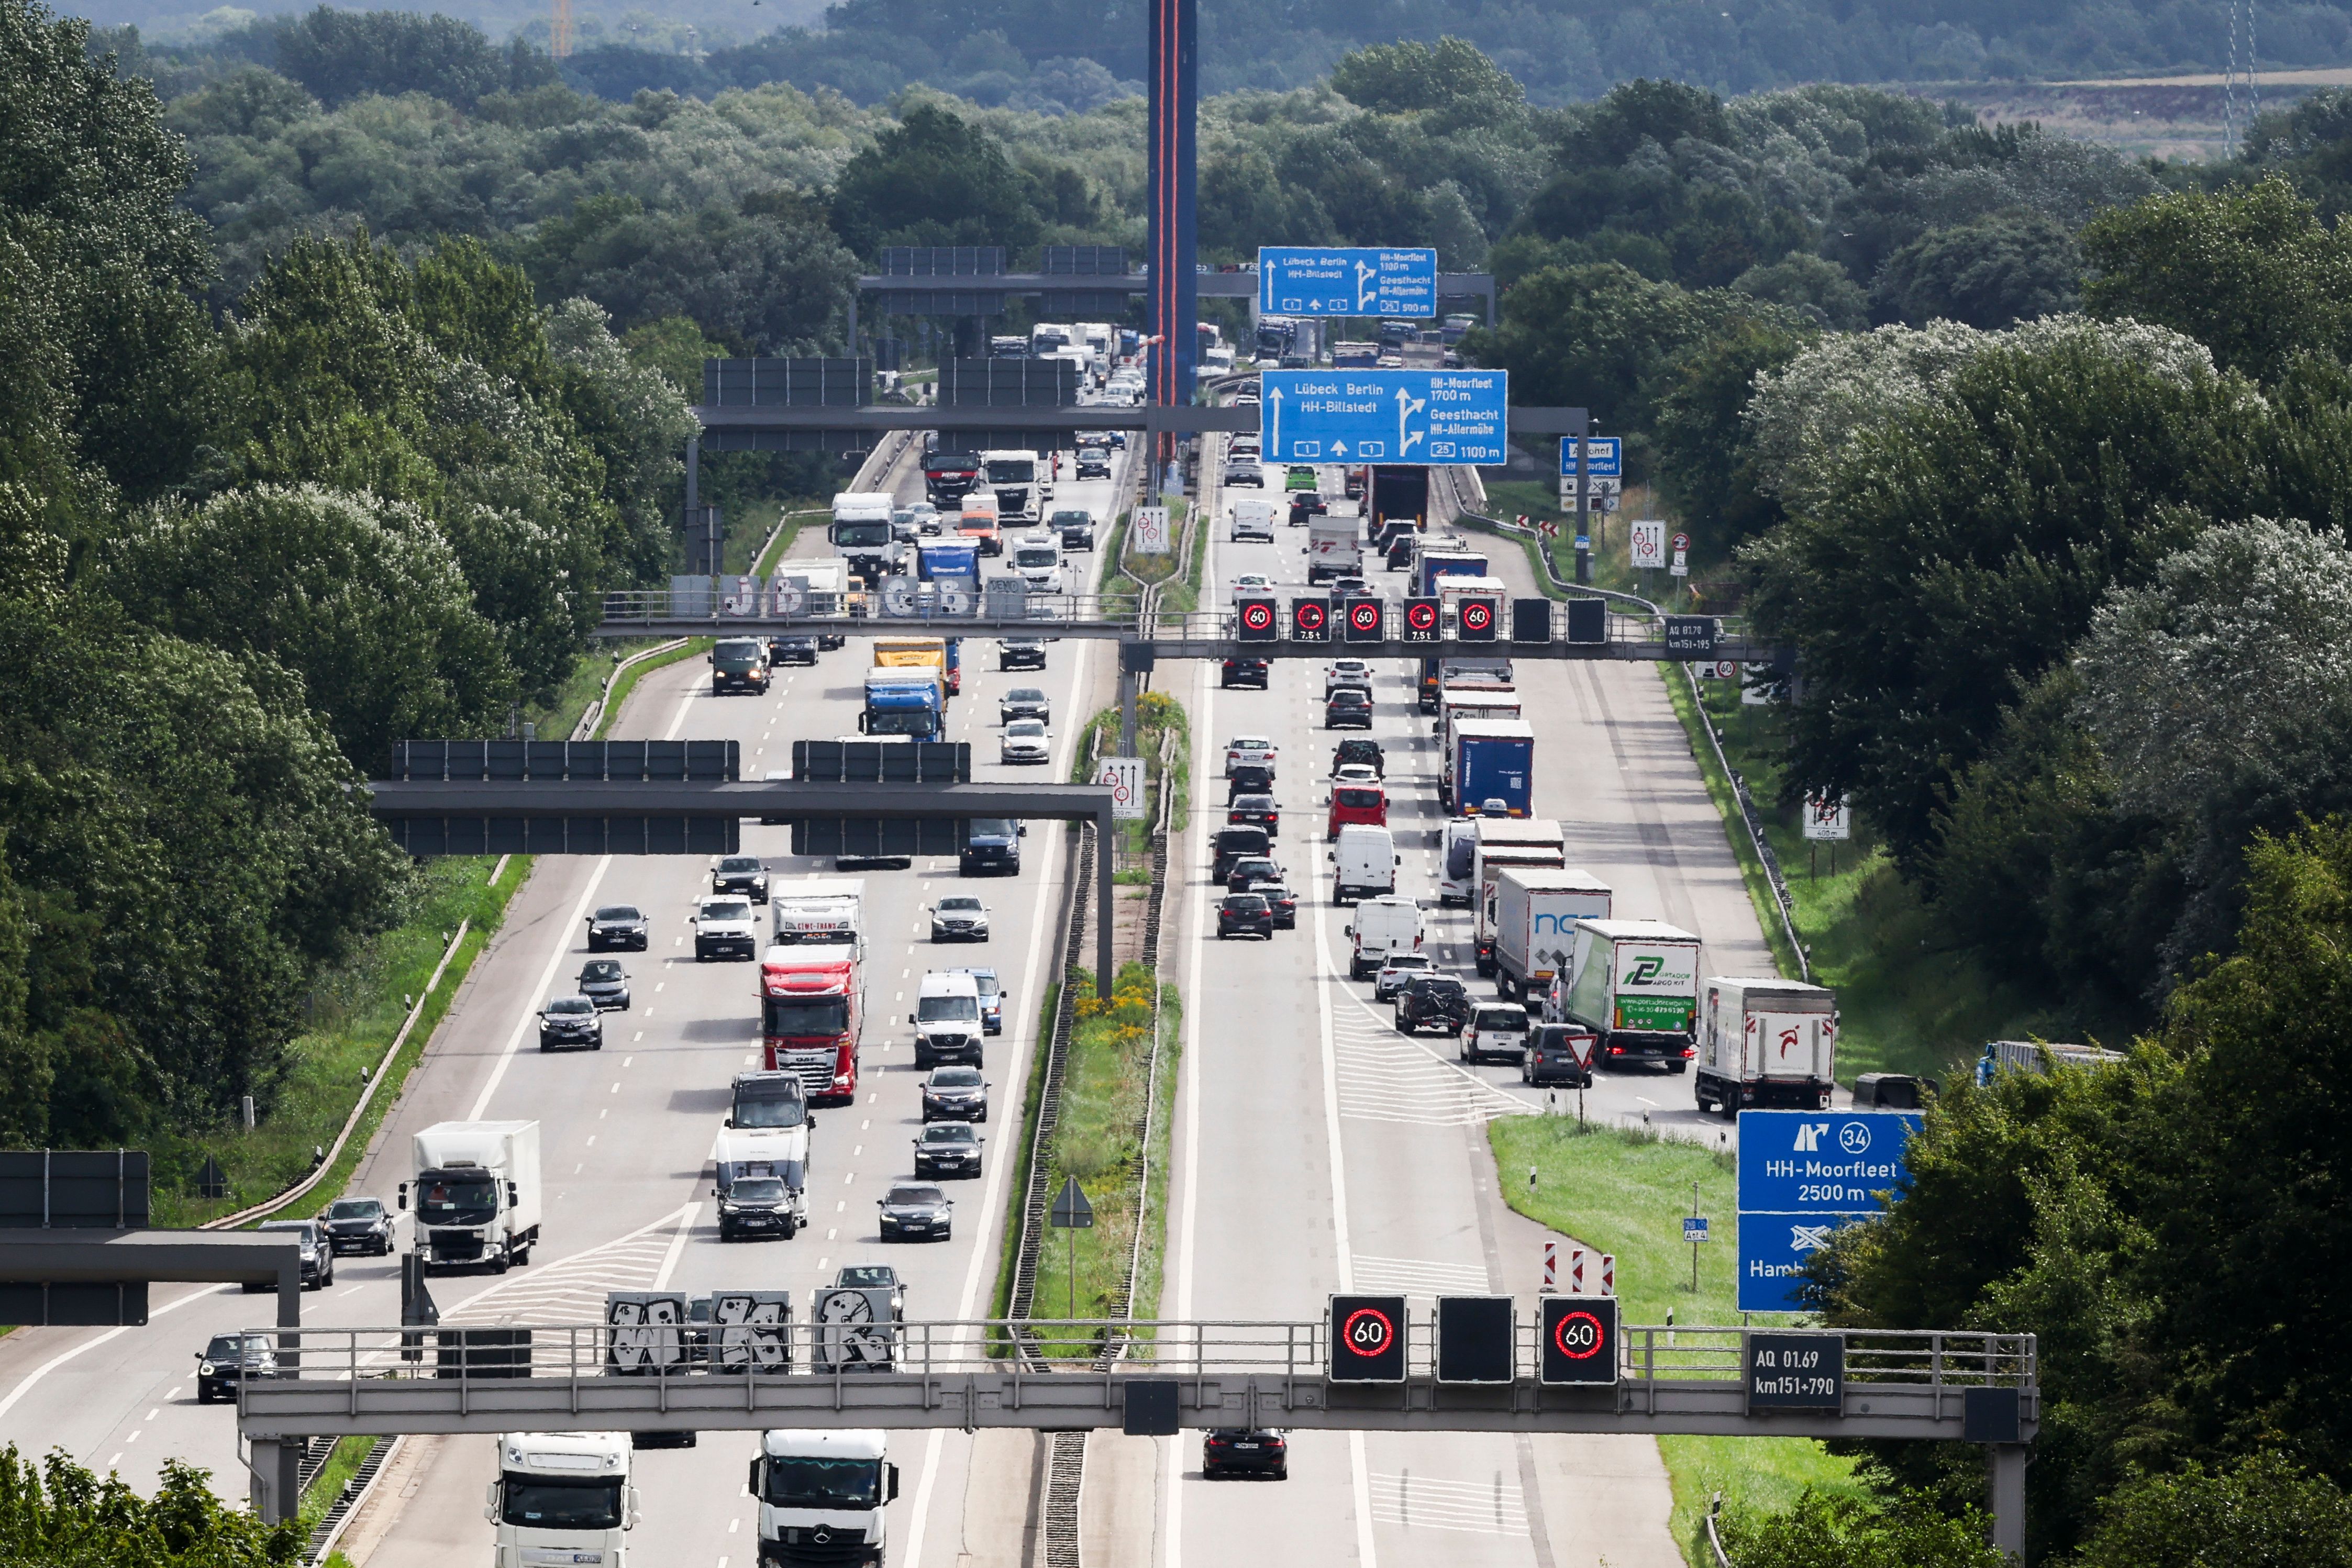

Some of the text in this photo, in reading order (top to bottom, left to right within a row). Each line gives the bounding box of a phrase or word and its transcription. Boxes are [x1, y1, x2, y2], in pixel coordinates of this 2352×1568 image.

[1283, 257, 1347, 266] Lübeck Berlin
[1288, 270, 1342, 279] HH-Billstedt
[1380, 276, 1430, 284] Geesthacht
[1430, 377, 1492, 388] HH-Moorfleet
[1295, 383, 1383, 395] Lübeck Berlin
[1431, 390, 1471, 401] 1700 m
[1301, 401, 1377, 413] HH-Billstedt
[1430, 409, 1499, 420] Geesthacht
[1430, 423, 1494, 435] HH-Allermöhe
[1436, 446, 1449, 454] 25
[1461, 447, 1500, 458] 1100 m
[1250, 610, 1266, 624] 60
[1357, 610, 1373, 624] 60
[1469, 610, 1485, 623] 60
[1315, 631, 1321, 640] t
[1426, 631, 1431, 640] t
[1669, 626, 1679, 635] AQ
[1721, 664, 1732, 673] 60
[1844, 1128, 1866, 1146] 34
[1767, 1160, 1896, 1178] HH-Moorfleet
[1798, 1185, 1865, 1202] 2500 m
[1355, 1322, 1383, 1343] 60
[1566, 1325, 1594, 1346] 60
[1756, 1351, 1776, 1367] AQ
[1755, 1377, 1834, 1395] km151+790
